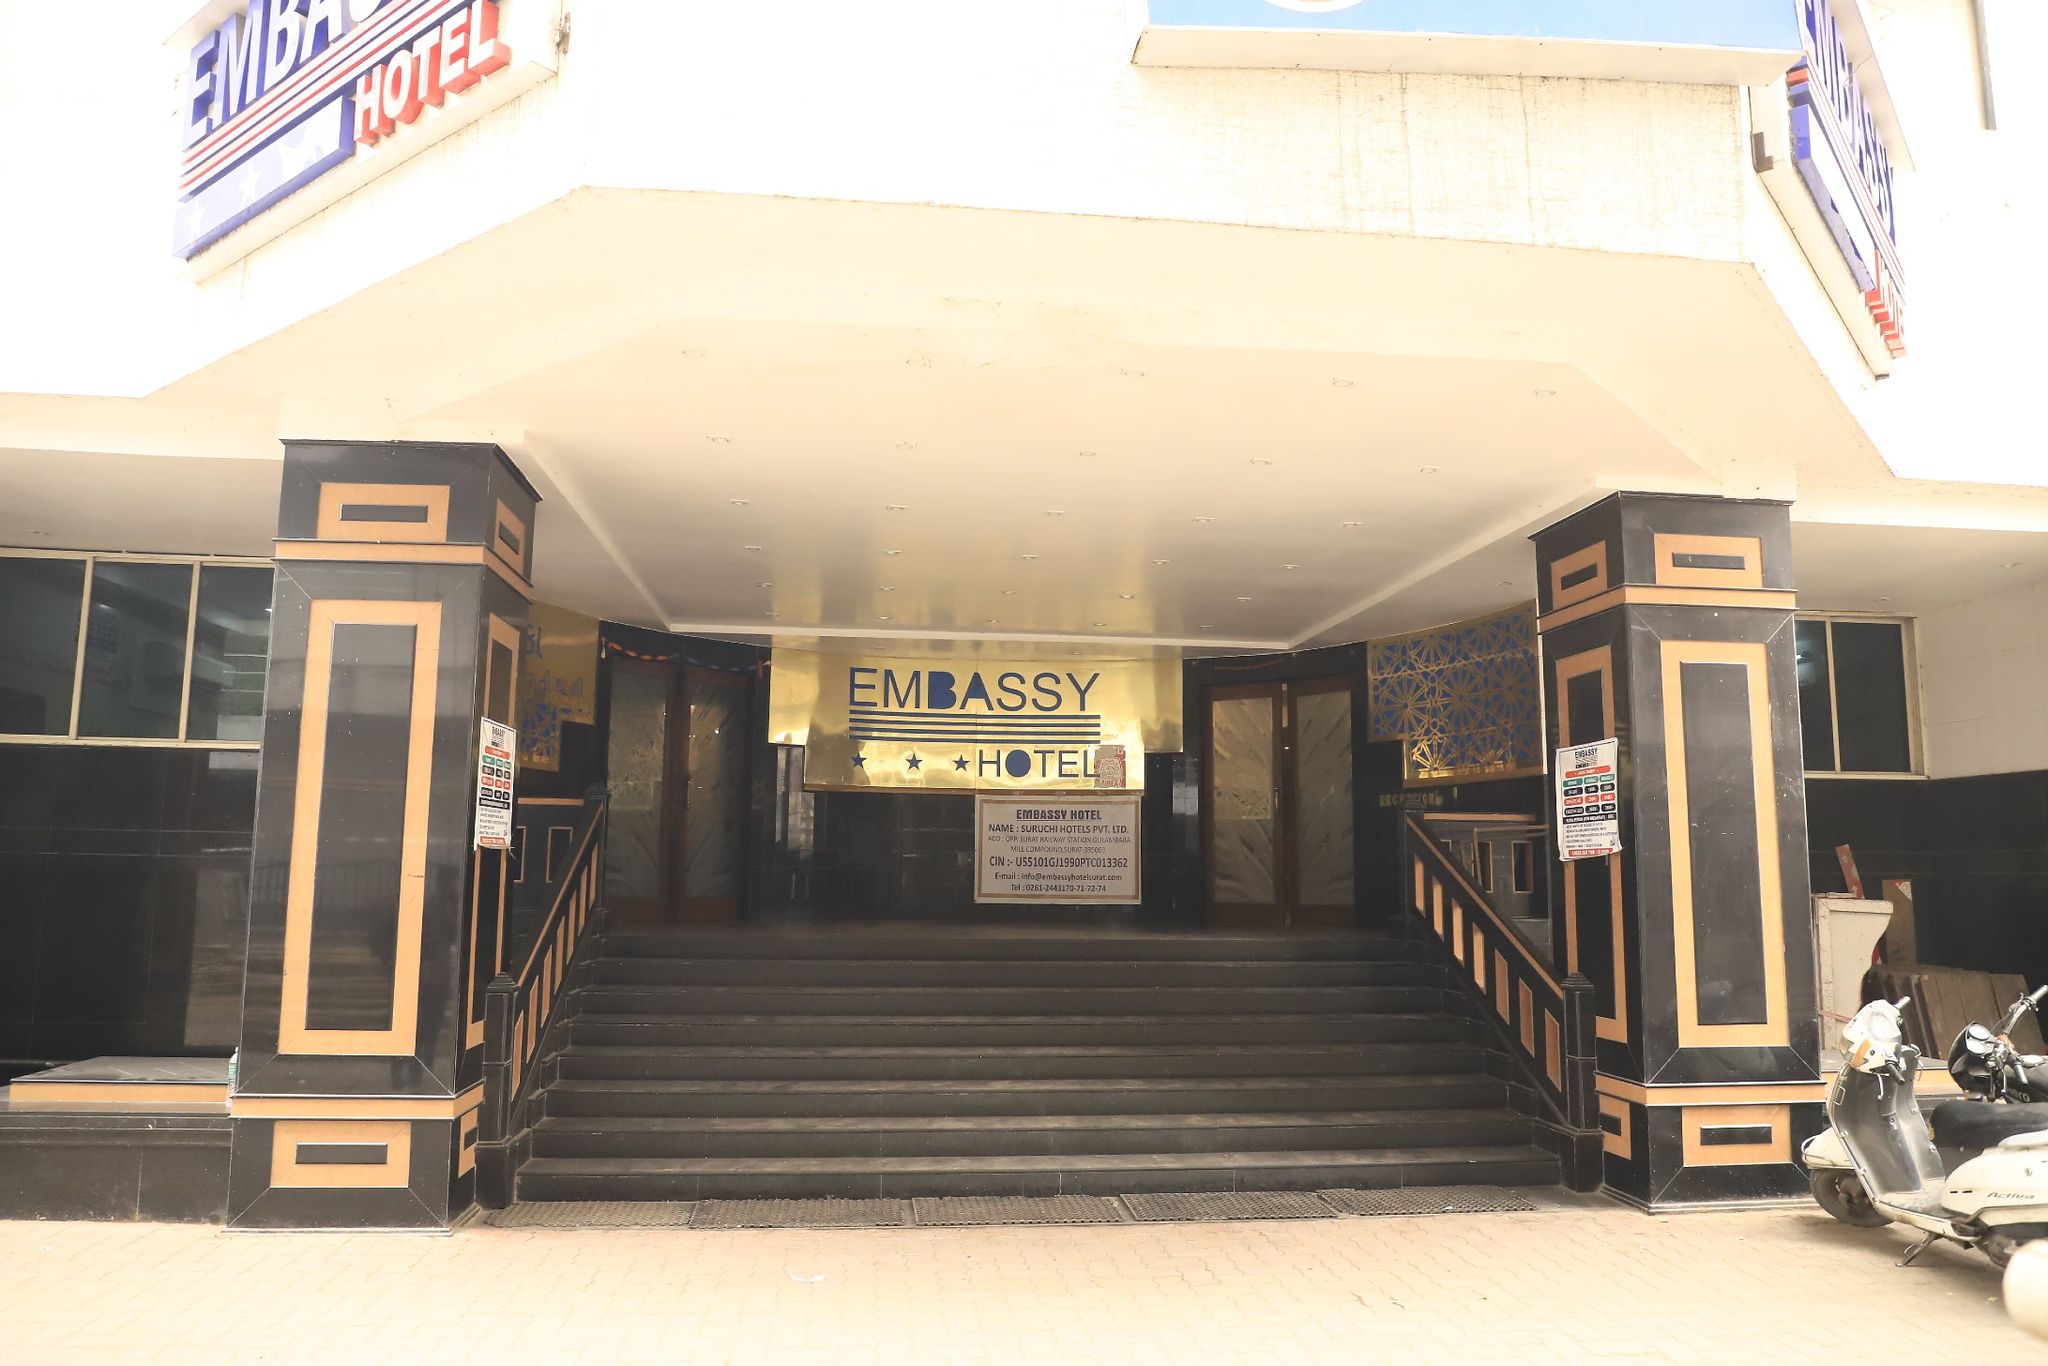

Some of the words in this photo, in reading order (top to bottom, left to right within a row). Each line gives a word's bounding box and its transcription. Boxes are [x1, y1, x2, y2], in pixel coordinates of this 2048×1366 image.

[184, 0, 384, 150] EMBA
[354, 0, 512, 147] HOTEL
[849, 667, 1100, 712] EMBASSY
[978, 749, 1101, 778] HOTEL
[1016, 809, 1067, 820] EMBASSY
[1070, 810, 1102, 820] HOTEL
[988, 824, 1014, 833] NAME
[1021, 824, 1058, 834] SURUCHI
[1060, 825, 1090, 834] HOTELS
[1093, 825, 1110, 834] PVT.
[1113, 825, 1129, 834] LTD.
[989, 856, 1005, 867] CIN
[1015, 857, 1128, 868] U55101GJ1990PTC013362
[995, 872, 1015, 880] E-mail
[1021, 872, 1122, 882] info@embassyhotelsurat.com
[1986, 1191, 2036, 1199] Activa
